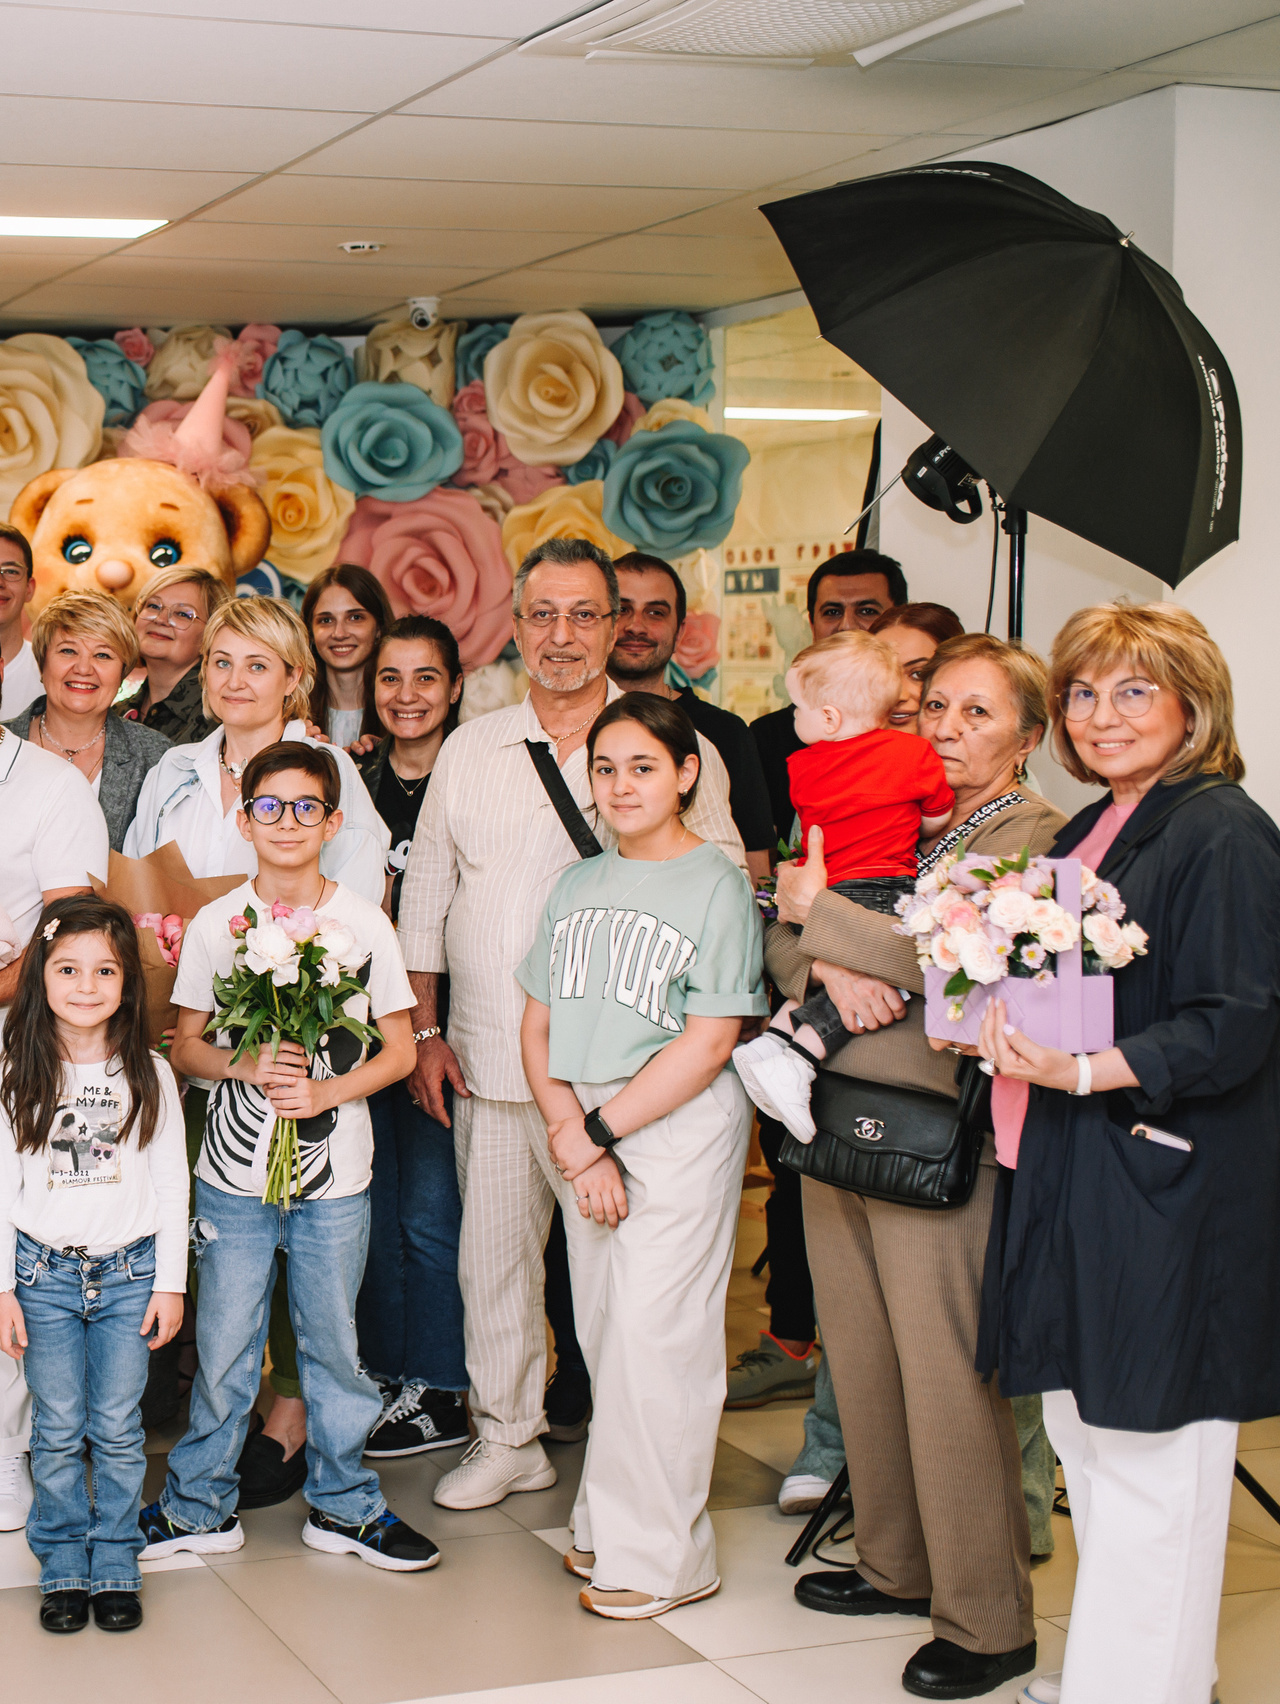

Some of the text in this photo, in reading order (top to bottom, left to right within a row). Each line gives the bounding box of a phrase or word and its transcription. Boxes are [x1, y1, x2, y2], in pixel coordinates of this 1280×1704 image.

[1215, 400, 1228, 510] Profoto
[549, 907, 698, 1033] EW YORK
[83, 1086, 113, 1096] ME &
[75, 1097, 120, 1109] MY BFF
[92, 1174, 119, 1182] FESTIVAL
